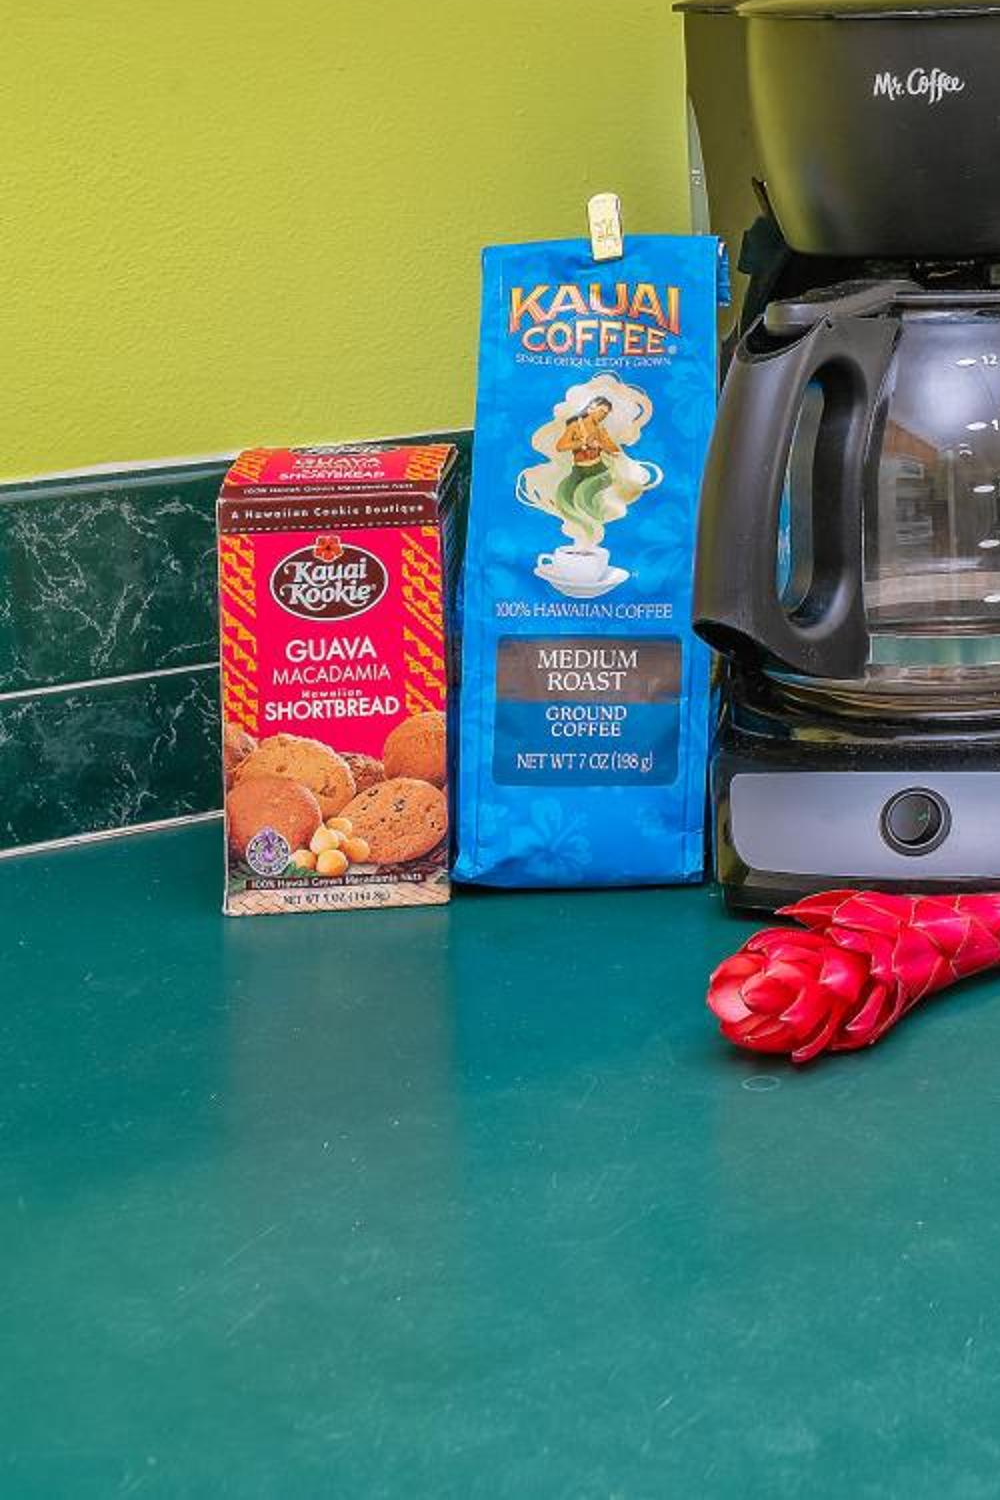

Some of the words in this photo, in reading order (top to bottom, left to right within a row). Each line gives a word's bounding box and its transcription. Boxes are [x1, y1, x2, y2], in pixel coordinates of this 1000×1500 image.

[873, 72, 905, 100] Mr.
[907, 67, 965, 104] Coffee
[509, 282, 681, 336] KAUAI
[521, 319, 667, 355] COFFEE
[515, 354, 551, 366] SINGLE
[633, 356, 672, 367] GROWN
[981, 354, 998, 366] 12
[231, 510, 239, 520] A
[245, 506, 309, 520] Hawaiian
[314, 504, 360, 517] Cookie
[365, 502, 424, 517] Boutique
[284, 557, 368, 587] Kauai
[279, 579, 372, 611] Kookie
[495, 603, 531, 618] 100%
[533, 603, 613, 618] HAWAIIAN
[615, 603, 673, 619] COFFEE
[285, 635, 377, 663] GUAVA
[537, 649, 639, 669] MEDIUM
[272, 663, 392, 686] MACADAMIA
[547, 671, 627, 691] ROAST
[301, 687, 363, 700] Hawaiian
[265, 695, 400, 722] SHORTBREAD
[545, 705, 627, 721] GROUND
[551, 722, 622, 737] COFFEE
[516, 752, 548, 770] NET
[550, 752, 577, 769] WT
[578, 752, 588, 769] 7
[589, 752, 609, 769] OZ
